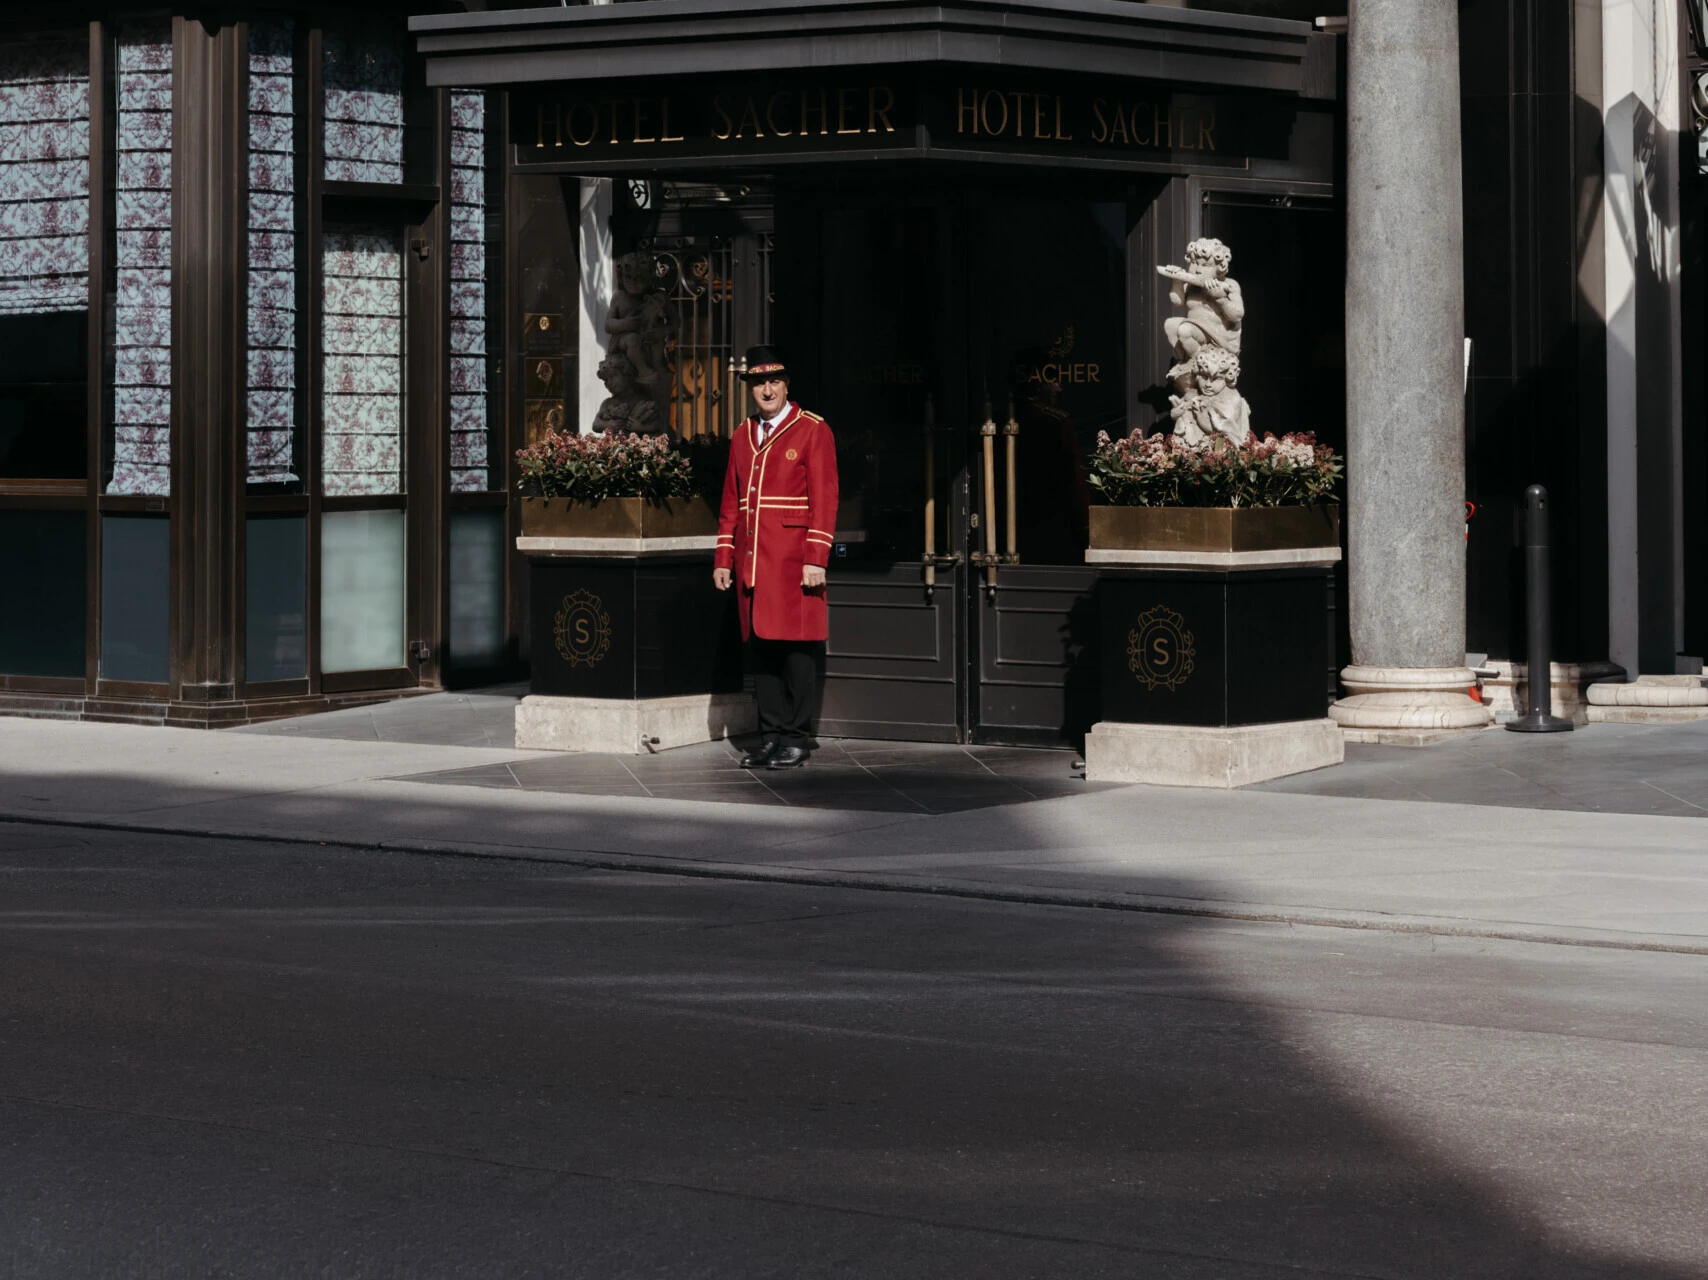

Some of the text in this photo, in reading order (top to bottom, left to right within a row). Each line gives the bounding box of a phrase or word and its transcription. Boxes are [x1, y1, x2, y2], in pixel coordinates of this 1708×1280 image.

[536, 86, 896, 148] HOTEL SACHER
[957, 87, 1216, 151] HOTEL SACHER
[1015, 362, 1101, 384] SACHER
[575, 617, 590, 644] S
[1153, 637, 1170, 666] S
